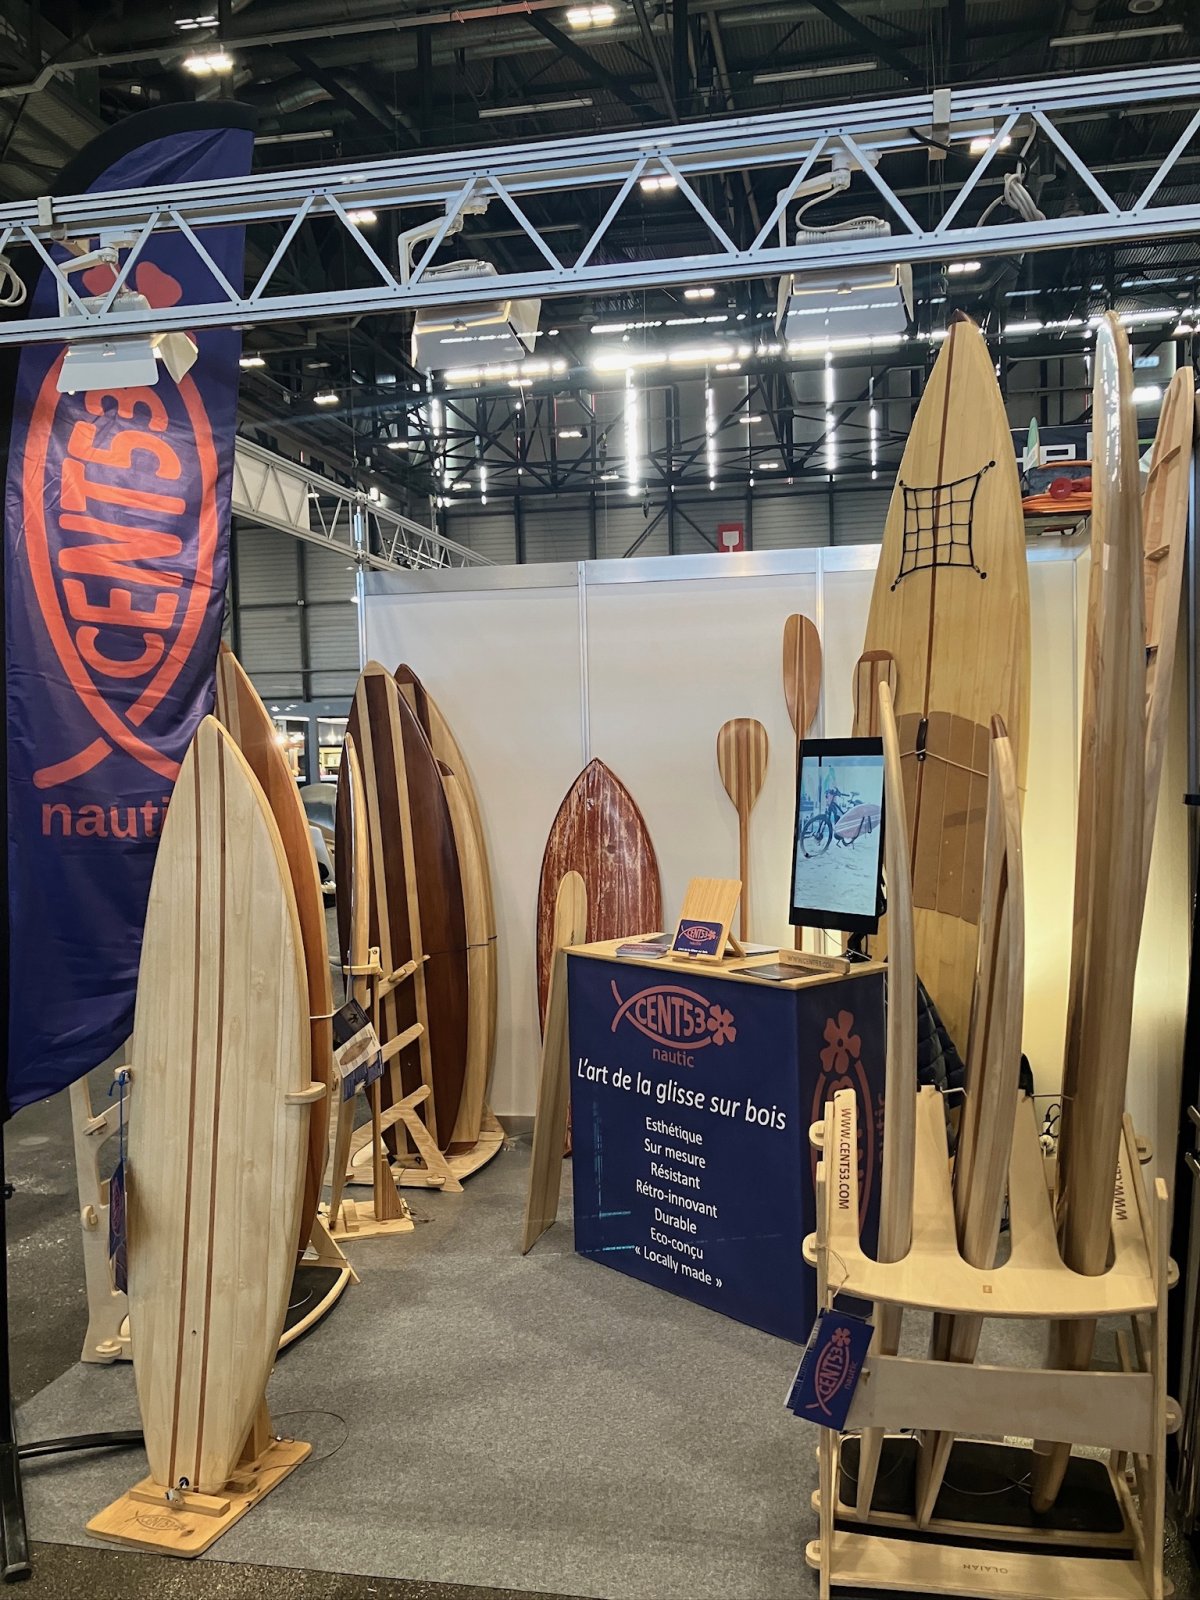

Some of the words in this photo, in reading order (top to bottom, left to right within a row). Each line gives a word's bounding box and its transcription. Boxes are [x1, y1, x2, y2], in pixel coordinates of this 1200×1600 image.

[58, 387, 186, 679] CENT53
[41, 798, 170, 838] nauti
[634, 994, 706, 1037] CENT53
[652, 1048, 695, 1068] nautic
[612, 1067, 632, 1091] de
[636, 1072, 652, 1096] la
[656, 1079, 706, 1109] glisse
[709, 1095, 741, 1119] sur
[744, 1098, 787, 1131] bois
[645, 1116, 703, 1146] Esthétique
[644, 1137, 662, 1155] Sur
[664, 1146, 706, 1169] mesure
[838, 1107, 851, 1211] WWW.CENT53.COM
[650, 1161, 701, 1190] Résistant
[636, 1178, 718, 1219] Rétro-innovant
[654, 1207, 697, 1234] Durable
[650, 1226, 704, 1260] Eco-conçu
[643, 1245, 679, 1274] Locally
[681, 1263, 712, 1285] made
[818, 1346, 844, 1395] CENT53
[962, 1563, 1008, 1574] OLAIAN
